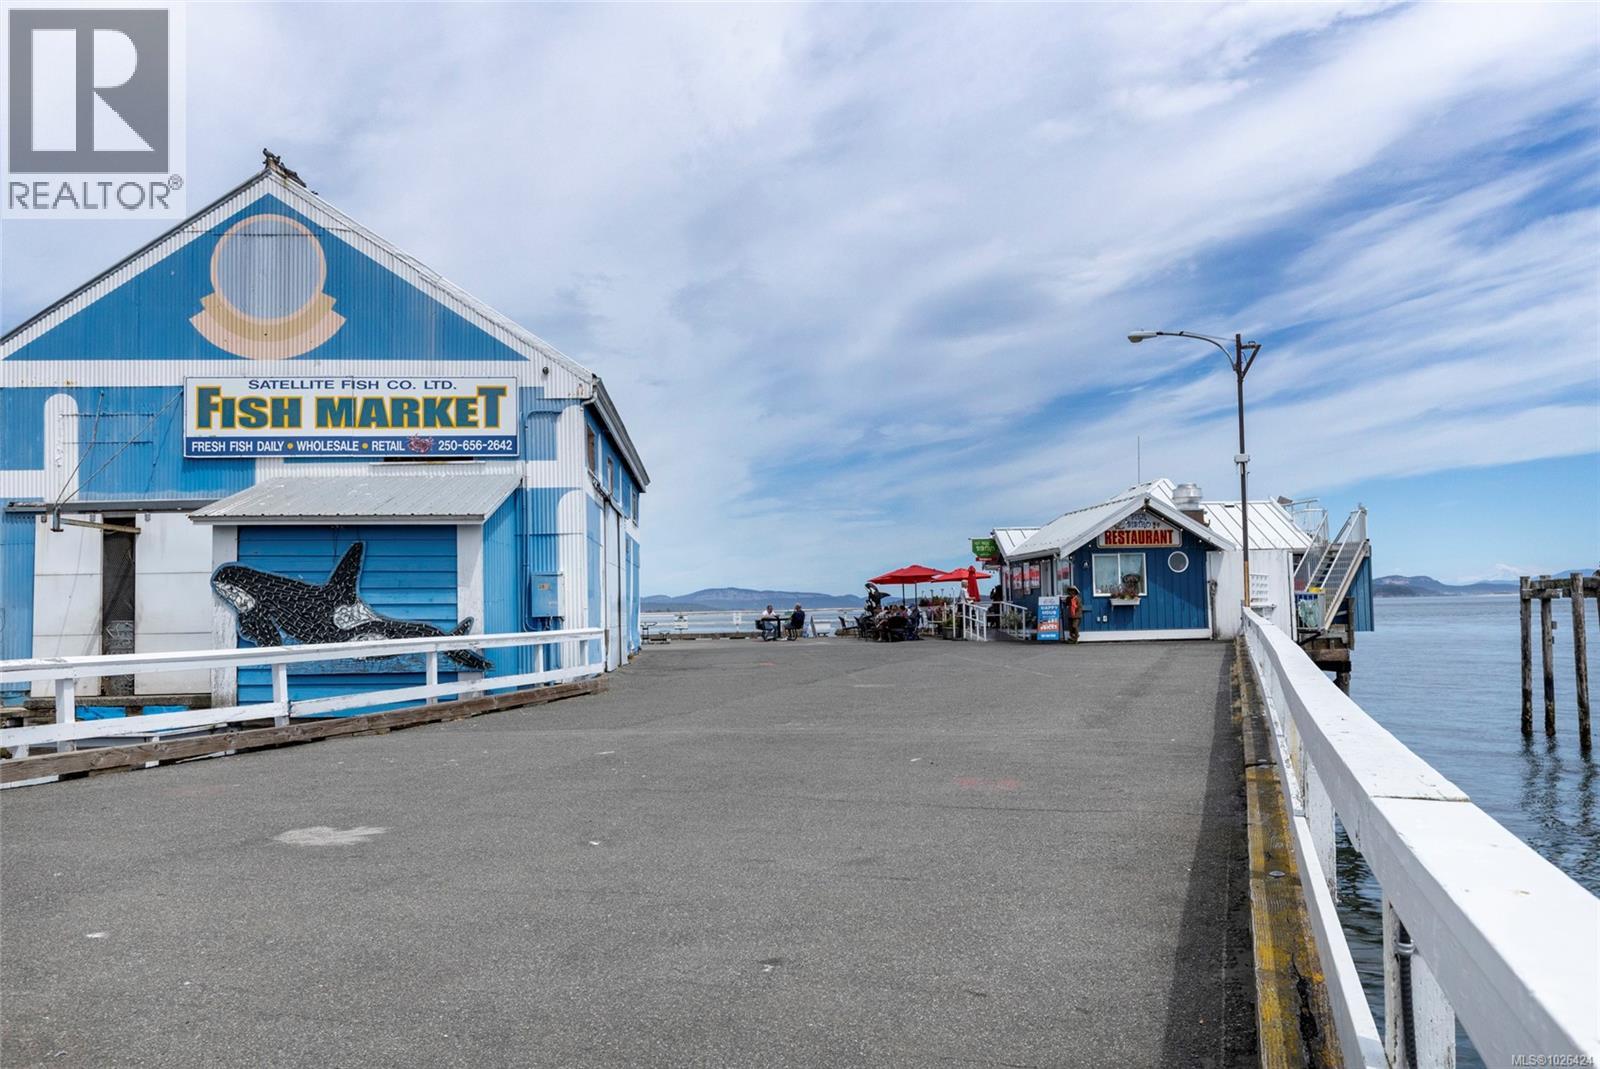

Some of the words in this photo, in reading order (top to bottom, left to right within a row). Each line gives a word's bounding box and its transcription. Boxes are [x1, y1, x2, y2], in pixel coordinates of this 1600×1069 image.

[248, 379, 334, 390] SATELLITE
[341, 380, 379, 390] FISH
[387, 380, 416, 390] CO.
[424, 380, 457, 390] LTD.
[195, 384, 303, 430] FISH
[313, 385, 508, 429] MARKET
[191, 441, 226, 452] FRESH
[229, 441, 253, 452] FISH
[256, 441, 285, 452] DAILY
[296, 440, 359, 452] WHOLESALE
[371, 440, 405, 452] RETAIL
[438, 439, 513, 452] 250-656-2642
[1104, 529, 1174, 545] RESTAURANT
